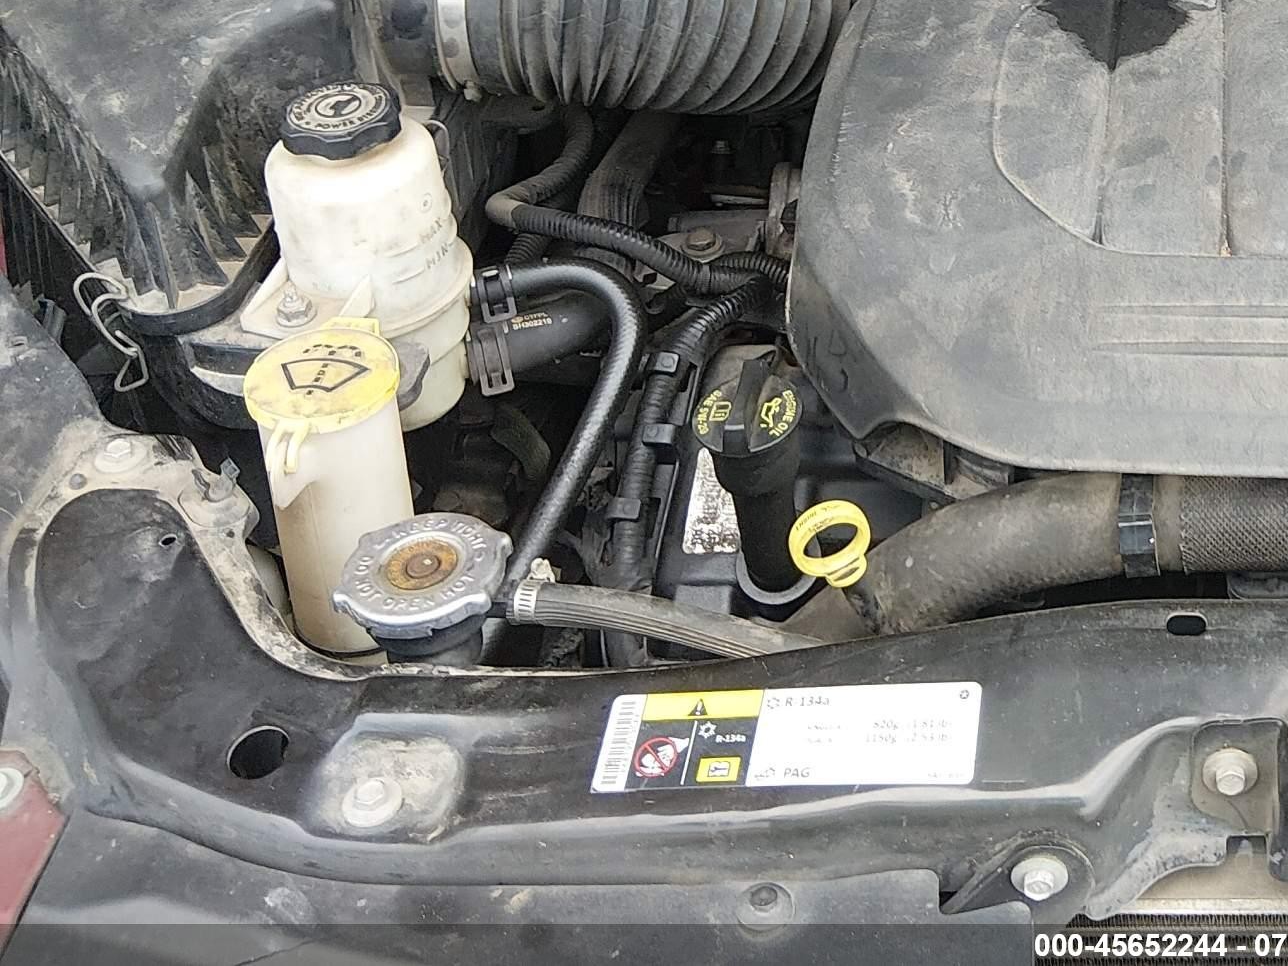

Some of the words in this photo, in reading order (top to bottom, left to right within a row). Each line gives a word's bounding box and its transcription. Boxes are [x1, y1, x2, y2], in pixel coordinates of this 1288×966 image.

[314, 120, 354, 130] POWER
[782, 389, 798, 423] ENGINE
[768, 417, 790, 438] OIL
[382, 596, 436, 612] OPEN
[783, 766, 811, 779] PAG
